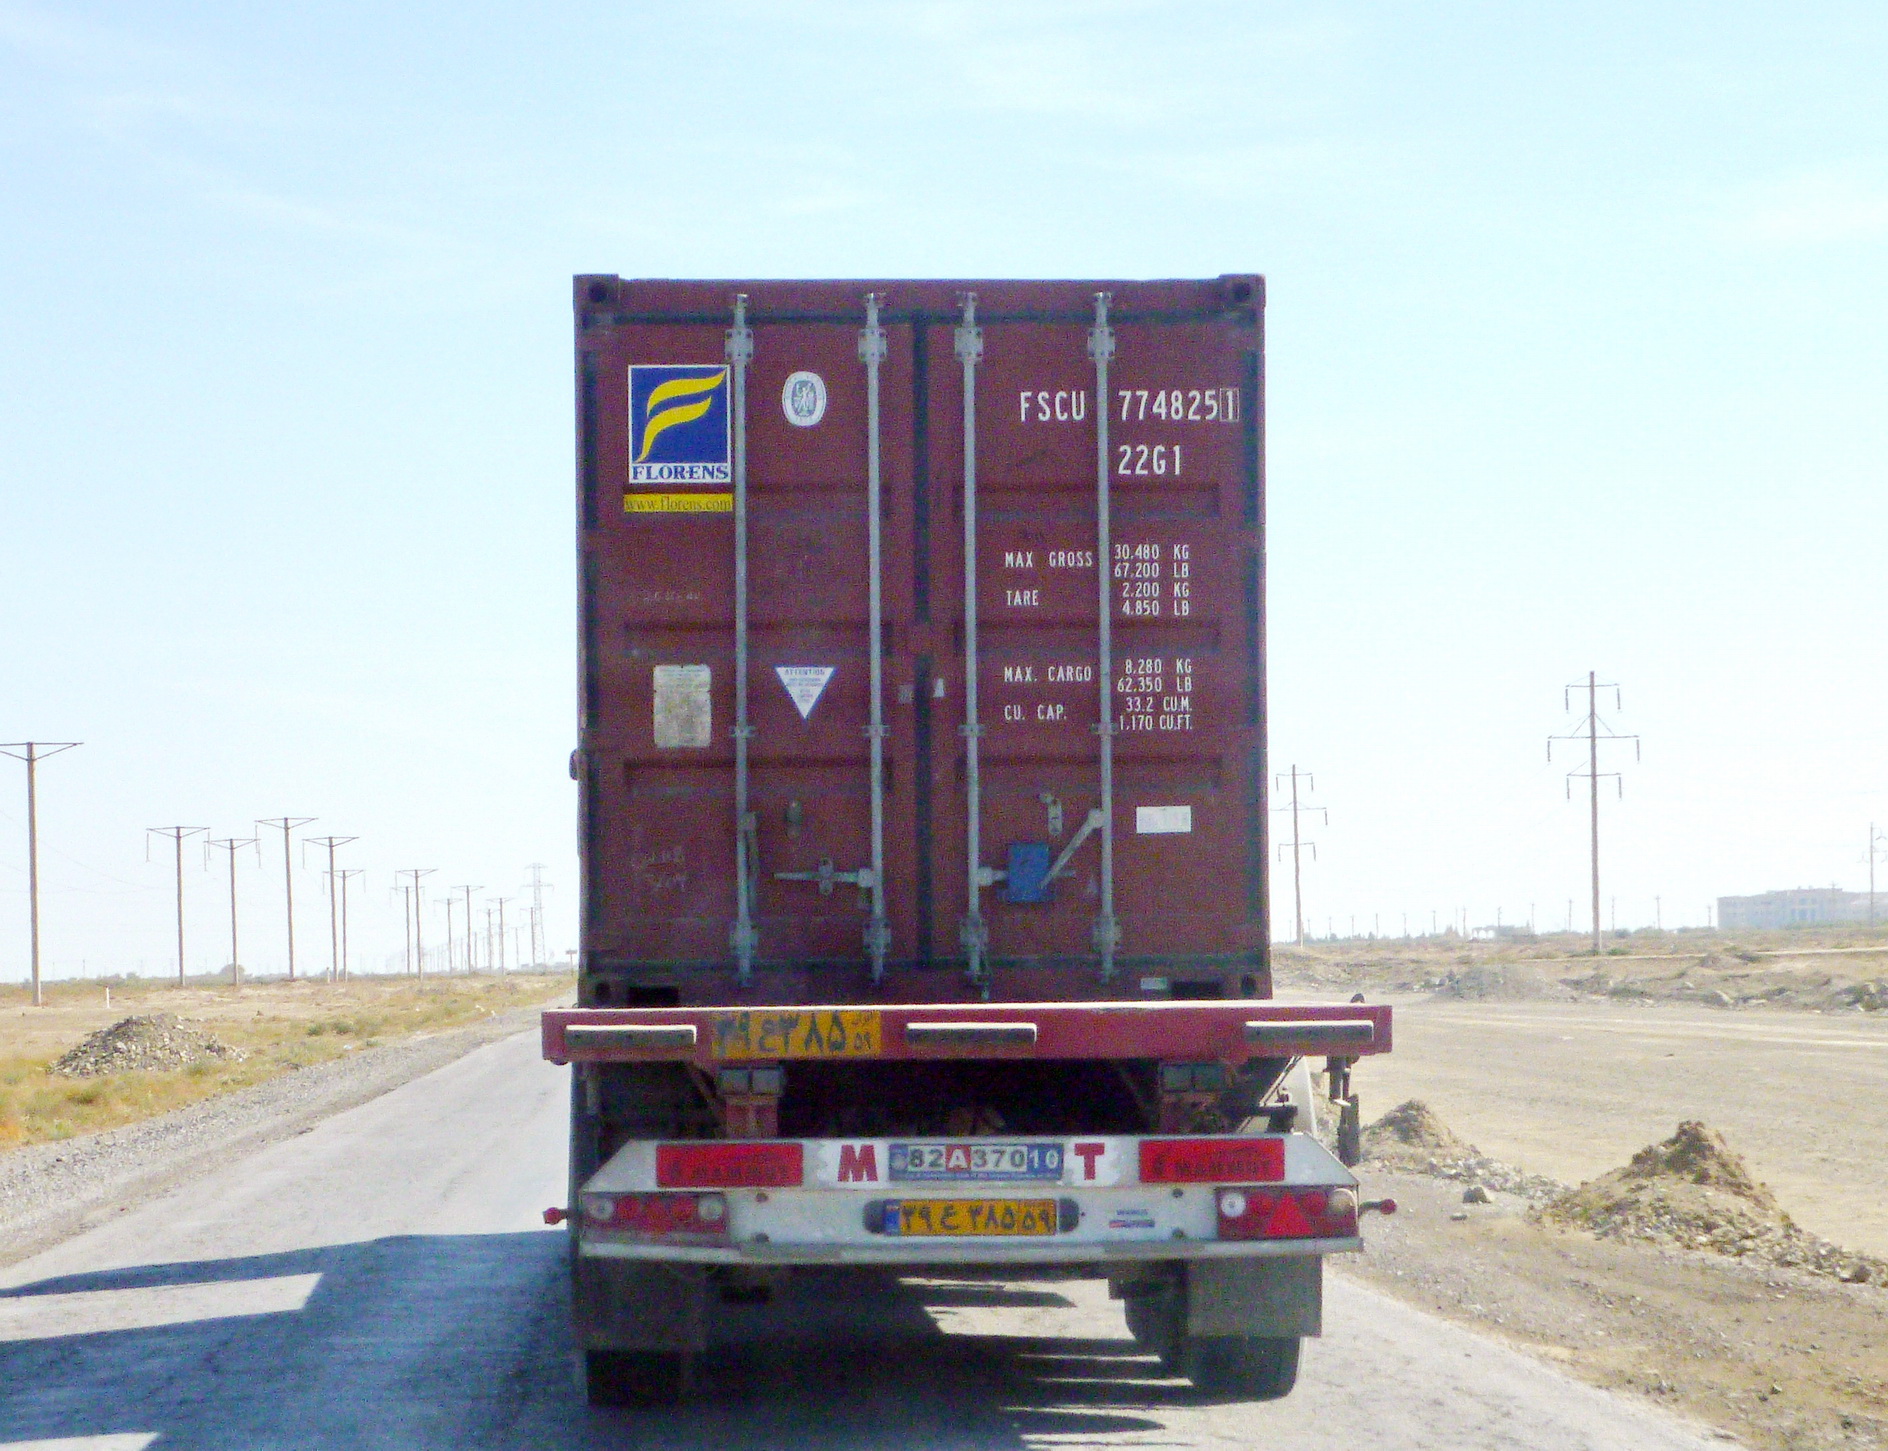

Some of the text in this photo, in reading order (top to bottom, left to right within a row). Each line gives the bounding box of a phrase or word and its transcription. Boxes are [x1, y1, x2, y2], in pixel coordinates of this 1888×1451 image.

[1020, 390, 1085, 422] FSCU
[1118, 445, 1181, 476] 22G1
[632, 464, 730, 480] FLORENS
[625, 495, 731, 511] www.florens.com
[1005, 551, 1093, 568] MAX GROSS
[1174, 544, 1190, 560] KG
[1174, 562, 1189, 578] LB
[1006, 589, 1039, 606] TARE
[1174, 582, 1190, 598] KG
[1174, 600, 1190, 616] LB
[1004, 666, 1092, 682] MAX. CARGO
[1176, 658, 1192, 675] KG
[1176, 676, 1192, 692] LB
[1126, 696, 1154, 712] 33.2
[1004, 704, 1067, 721] CU. CAP.
[838, 1144, 879, 1182] M
[1074, 1143, 1105, 1180] T
